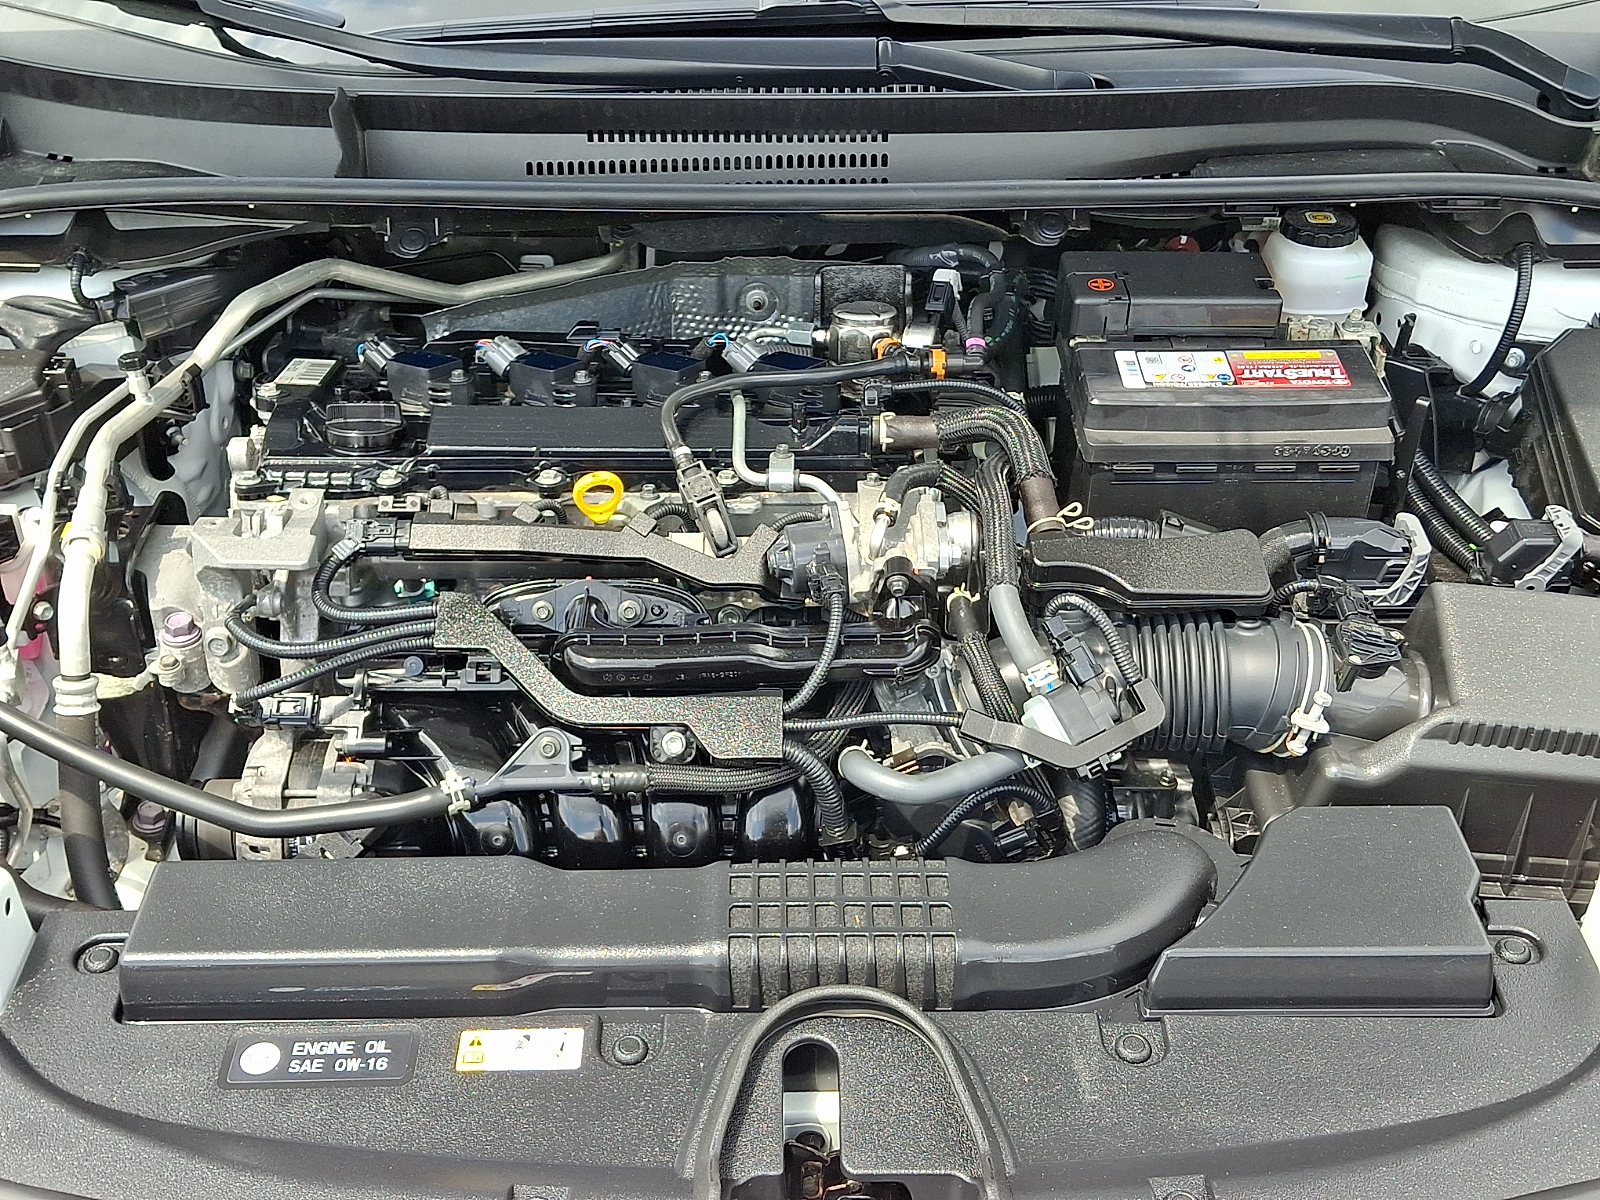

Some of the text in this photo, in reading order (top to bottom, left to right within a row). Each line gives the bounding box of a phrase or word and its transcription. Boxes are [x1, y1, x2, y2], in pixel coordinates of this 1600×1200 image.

[291, 1040, 392, 1056] ENGINE OIL
[288, 1057, 389, 1073] SAE 0W-16
